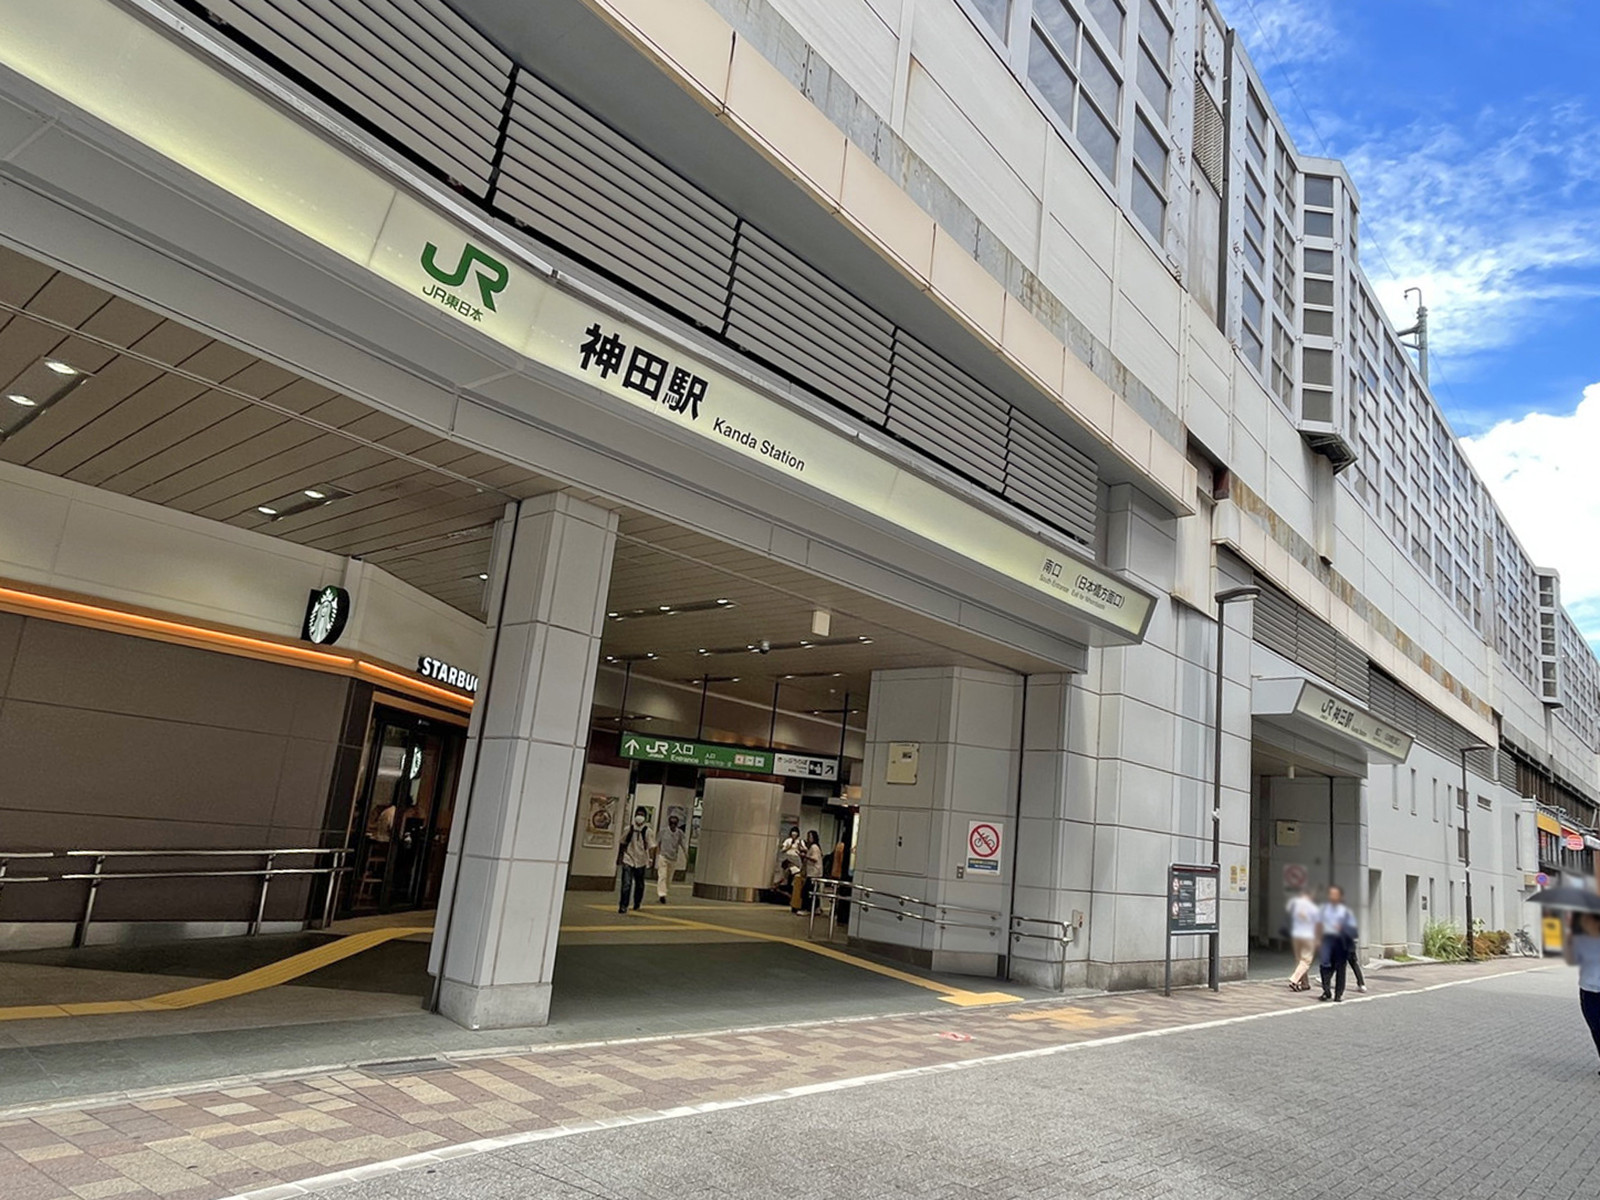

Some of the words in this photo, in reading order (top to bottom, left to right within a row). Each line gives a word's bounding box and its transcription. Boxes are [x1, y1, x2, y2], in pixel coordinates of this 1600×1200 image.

[421, 241, 509, 313] JR
[422, 284, 484, 323] JR東日本
[579, 323, 708, 420] 神田駅
[713, 416, 757, 450] Kanda
[760, 438, 806, 472] Station
[1043, 558, 1062, 578] 南口
[1321, 699, 1335, 716] JR
[646, 741, 668, 755] JR
[672, 743, 693, 755] 入口
[670, 754, 699, 764] Entrance
